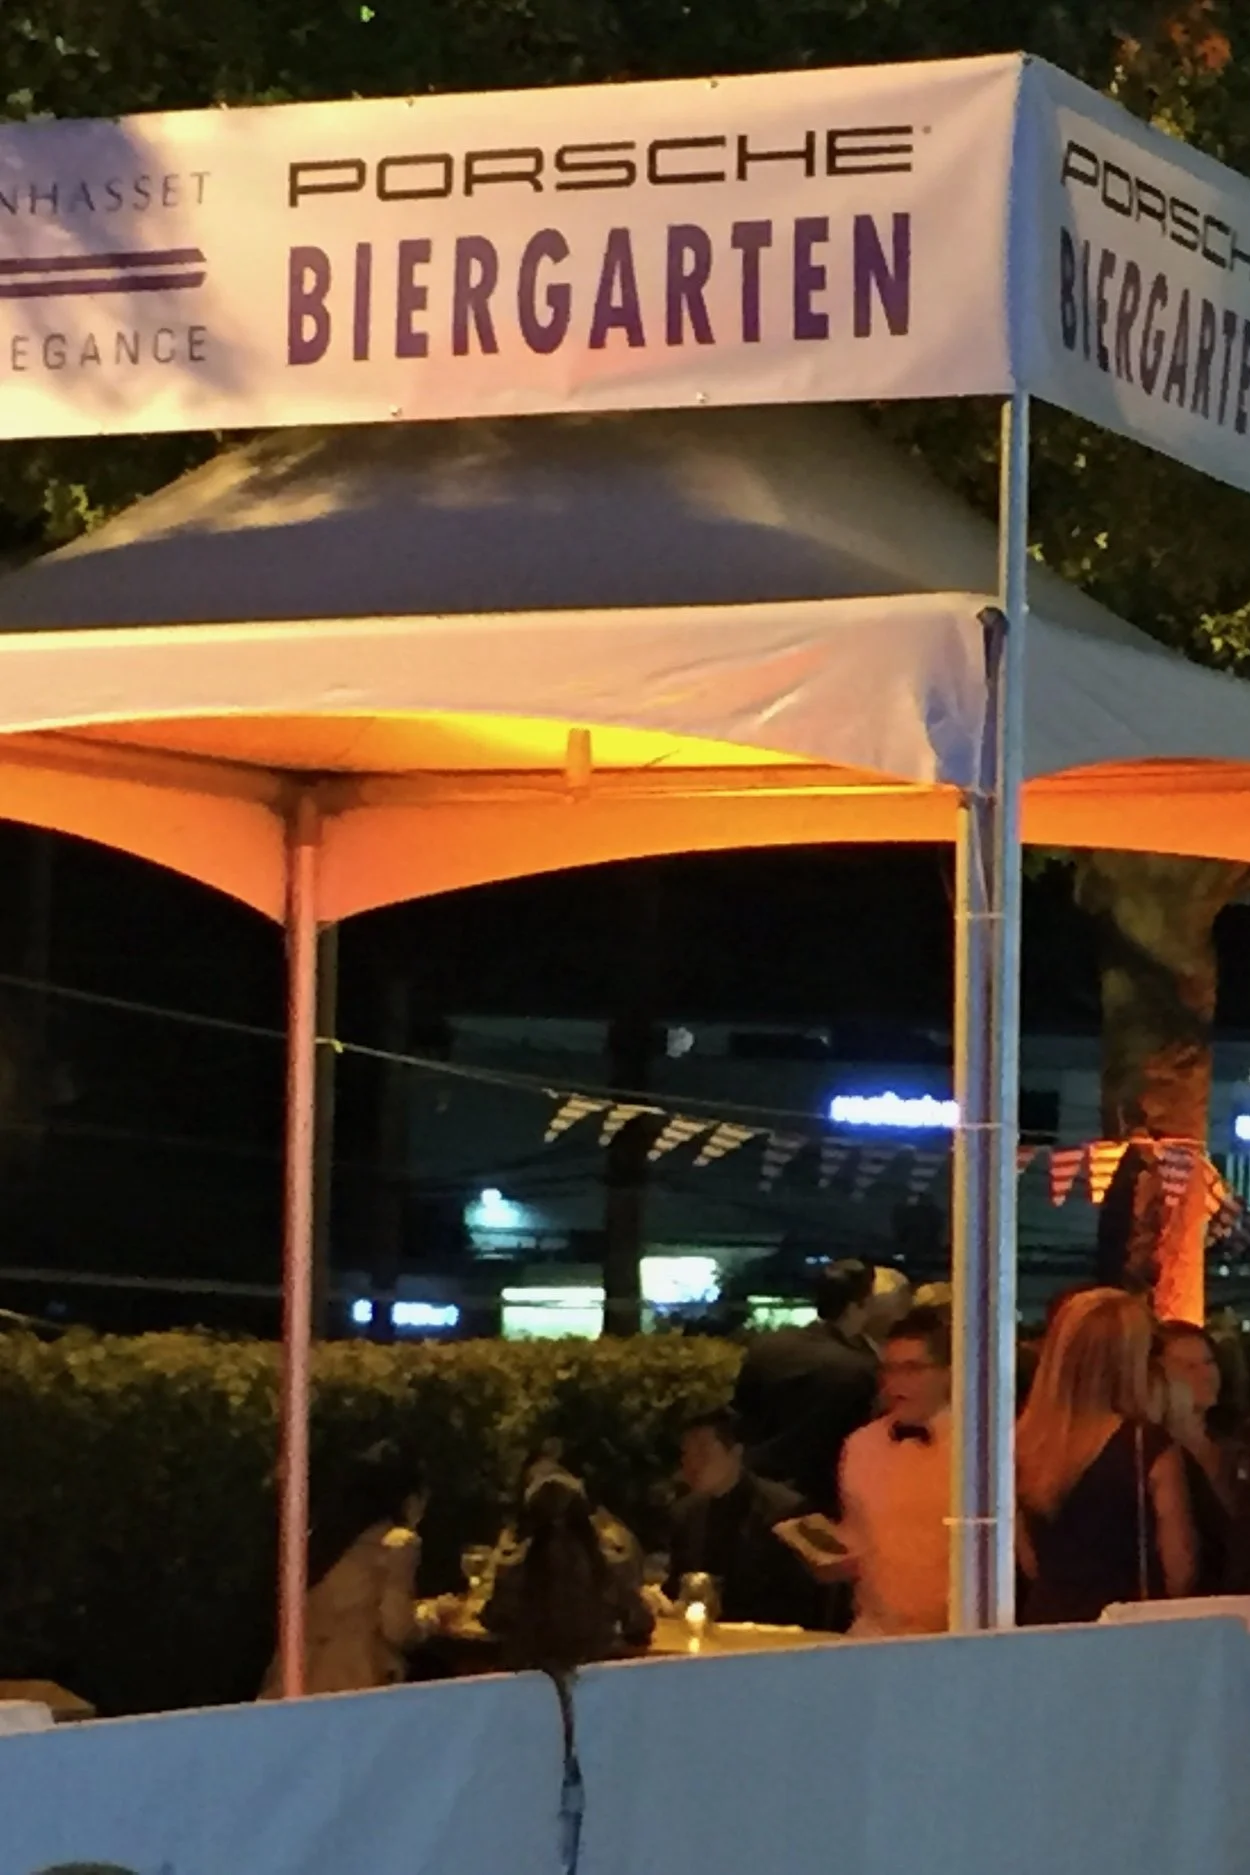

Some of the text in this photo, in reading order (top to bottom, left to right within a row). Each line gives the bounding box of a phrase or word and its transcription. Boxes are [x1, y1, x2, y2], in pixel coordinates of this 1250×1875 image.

[289, 125, 913, 208] PORSCHE
[287, 212, 911, 366] BIERGARTEN
[11, 325, 208, 371] EGANCE
